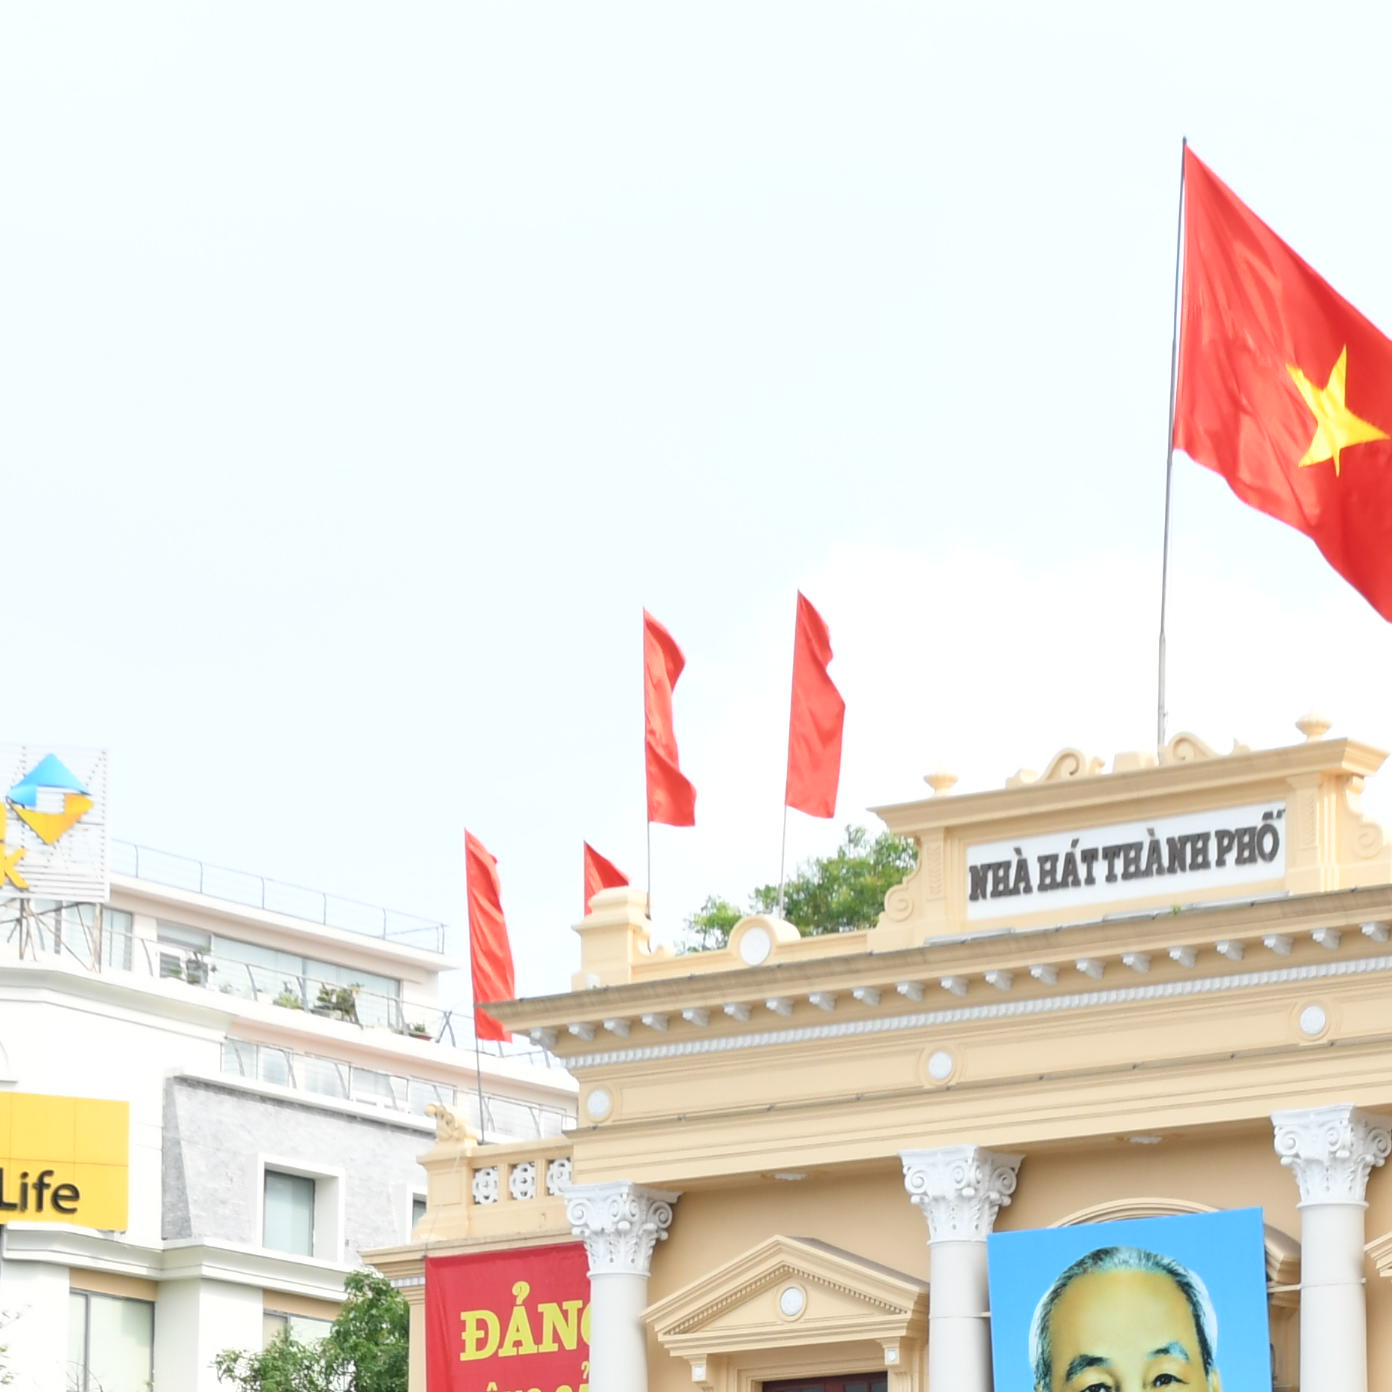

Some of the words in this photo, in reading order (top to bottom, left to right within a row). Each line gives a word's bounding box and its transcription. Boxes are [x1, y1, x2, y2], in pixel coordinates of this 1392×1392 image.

[969, 847, 1033, 902] NHÀ
[1037, 839, 1099, 893] HÁT
[1102, 826, 1211, 883] THÀNH
[1214, 809, 1287, 868] PHỐ
[459, 1281, 590, 1361] ĐẢN
